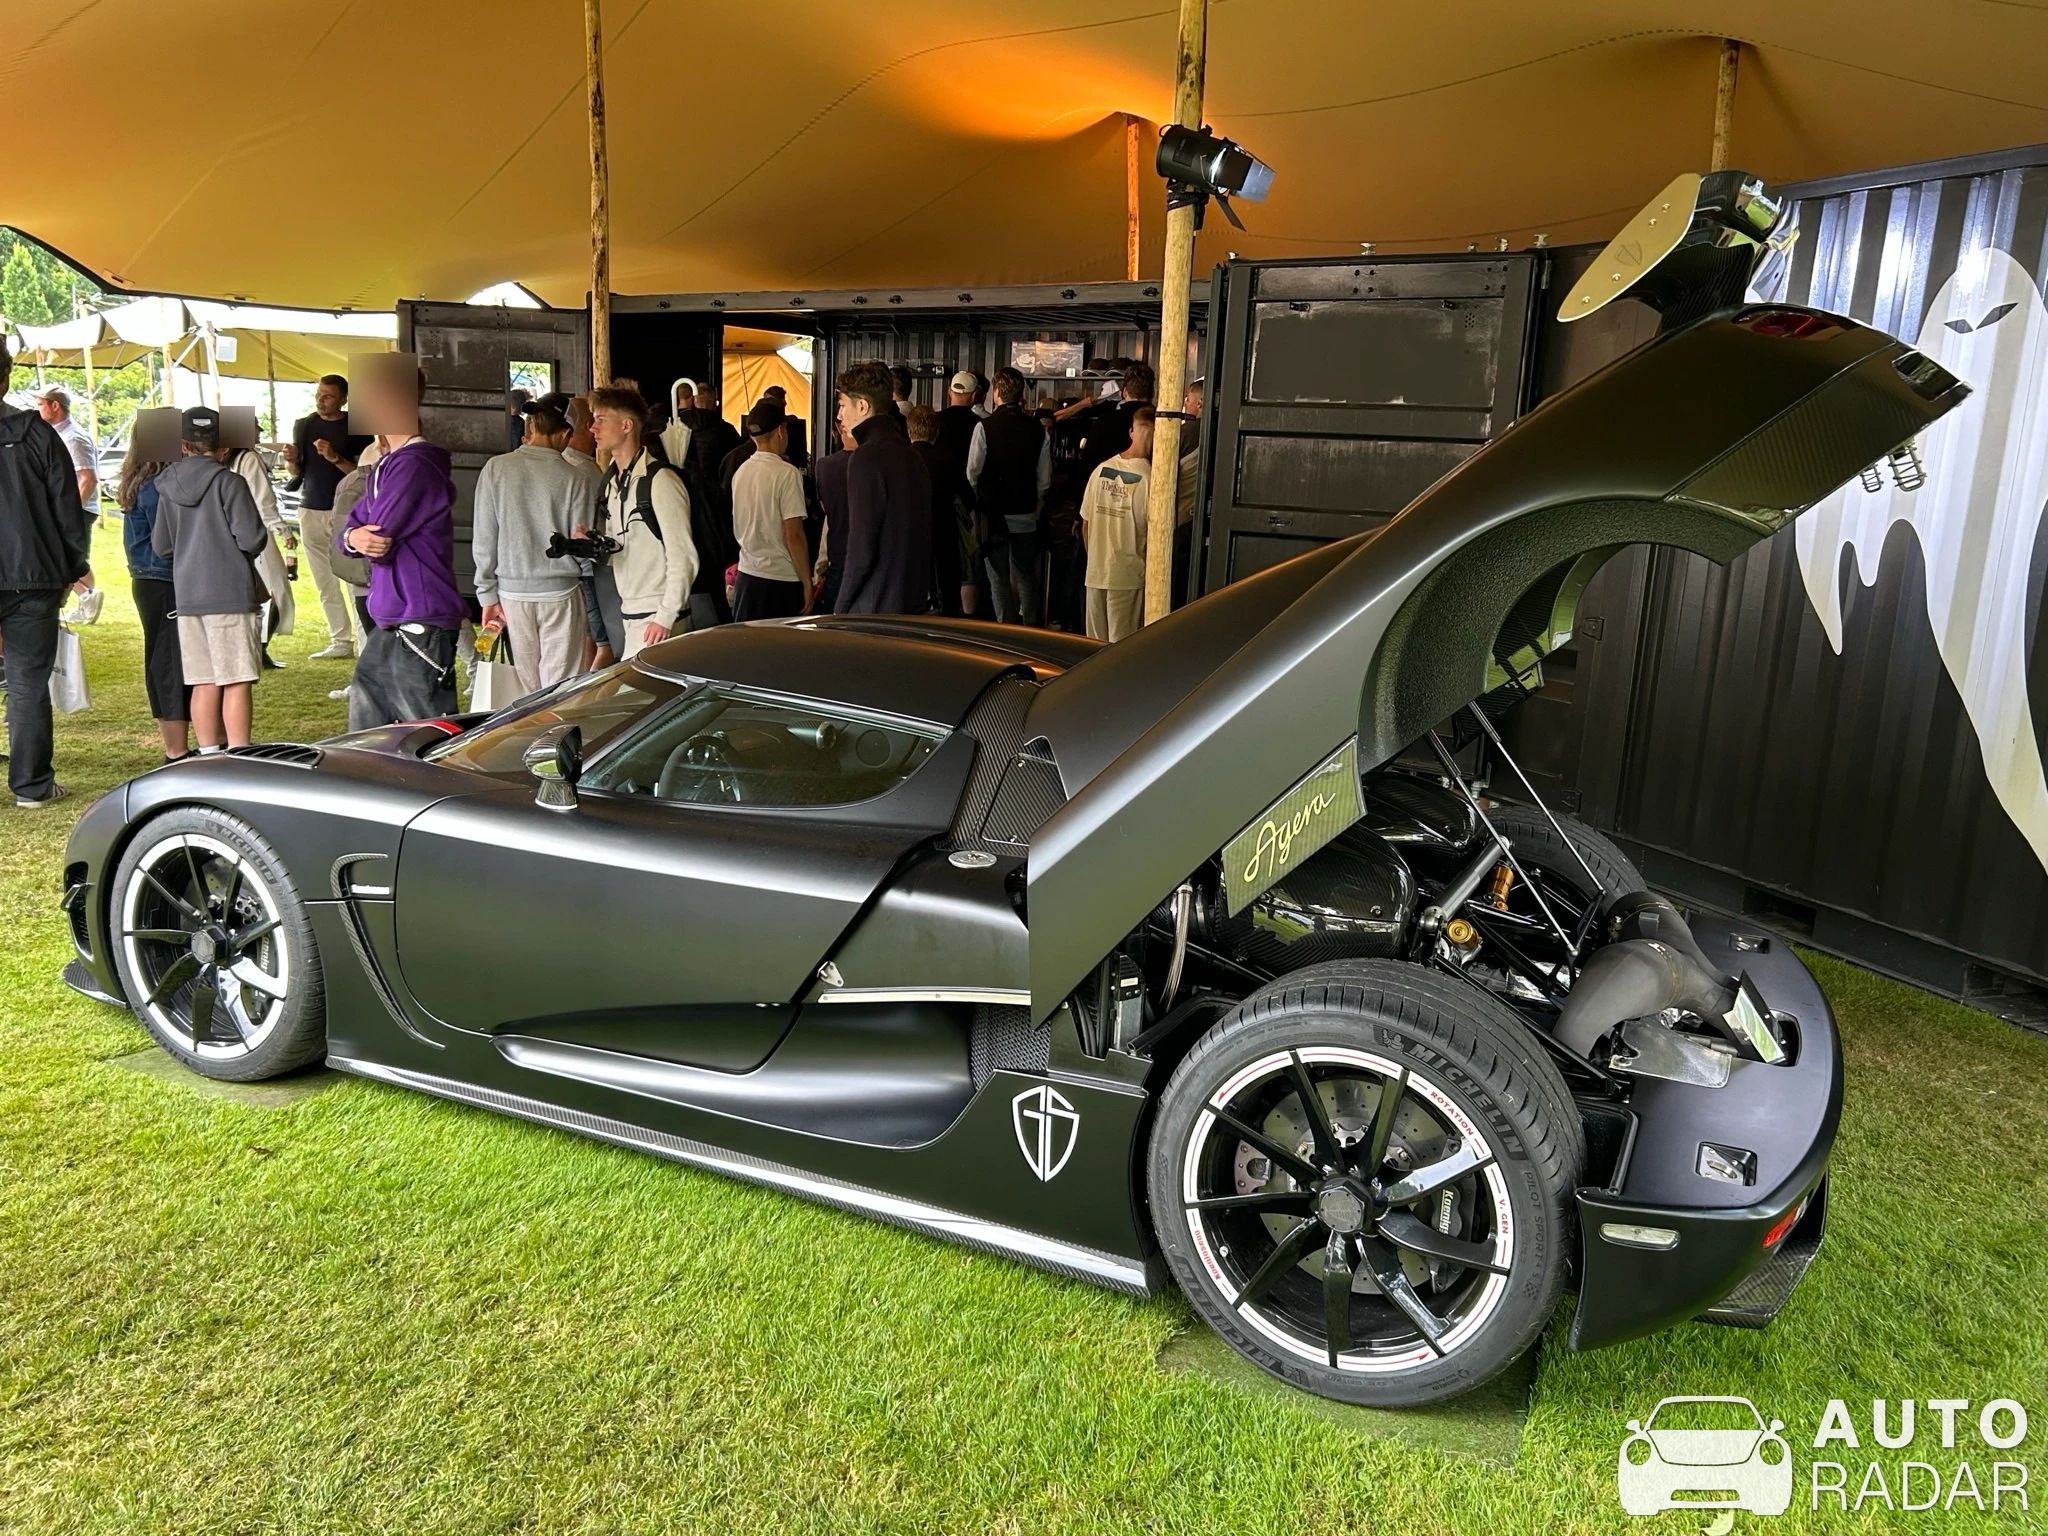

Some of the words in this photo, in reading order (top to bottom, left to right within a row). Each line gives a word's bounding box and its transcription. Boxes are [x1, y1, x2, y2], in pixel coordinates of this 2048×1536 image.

[219, 825, 275, 883] MICHELIN
[1243, 792, 1336, 883] Agera
[1409, 1043, 1525, 1154] MICHELIN
[1430, 1091, 1474, 1136] ROTATION
[1501, 1213, 1509, 1234] GEN
[1524, 1171, 1541, 1208] PILOT
[1534, 1215, 1544, 1257] SPORT
[1177, 1261, 1278, 1368] MICHELIN
